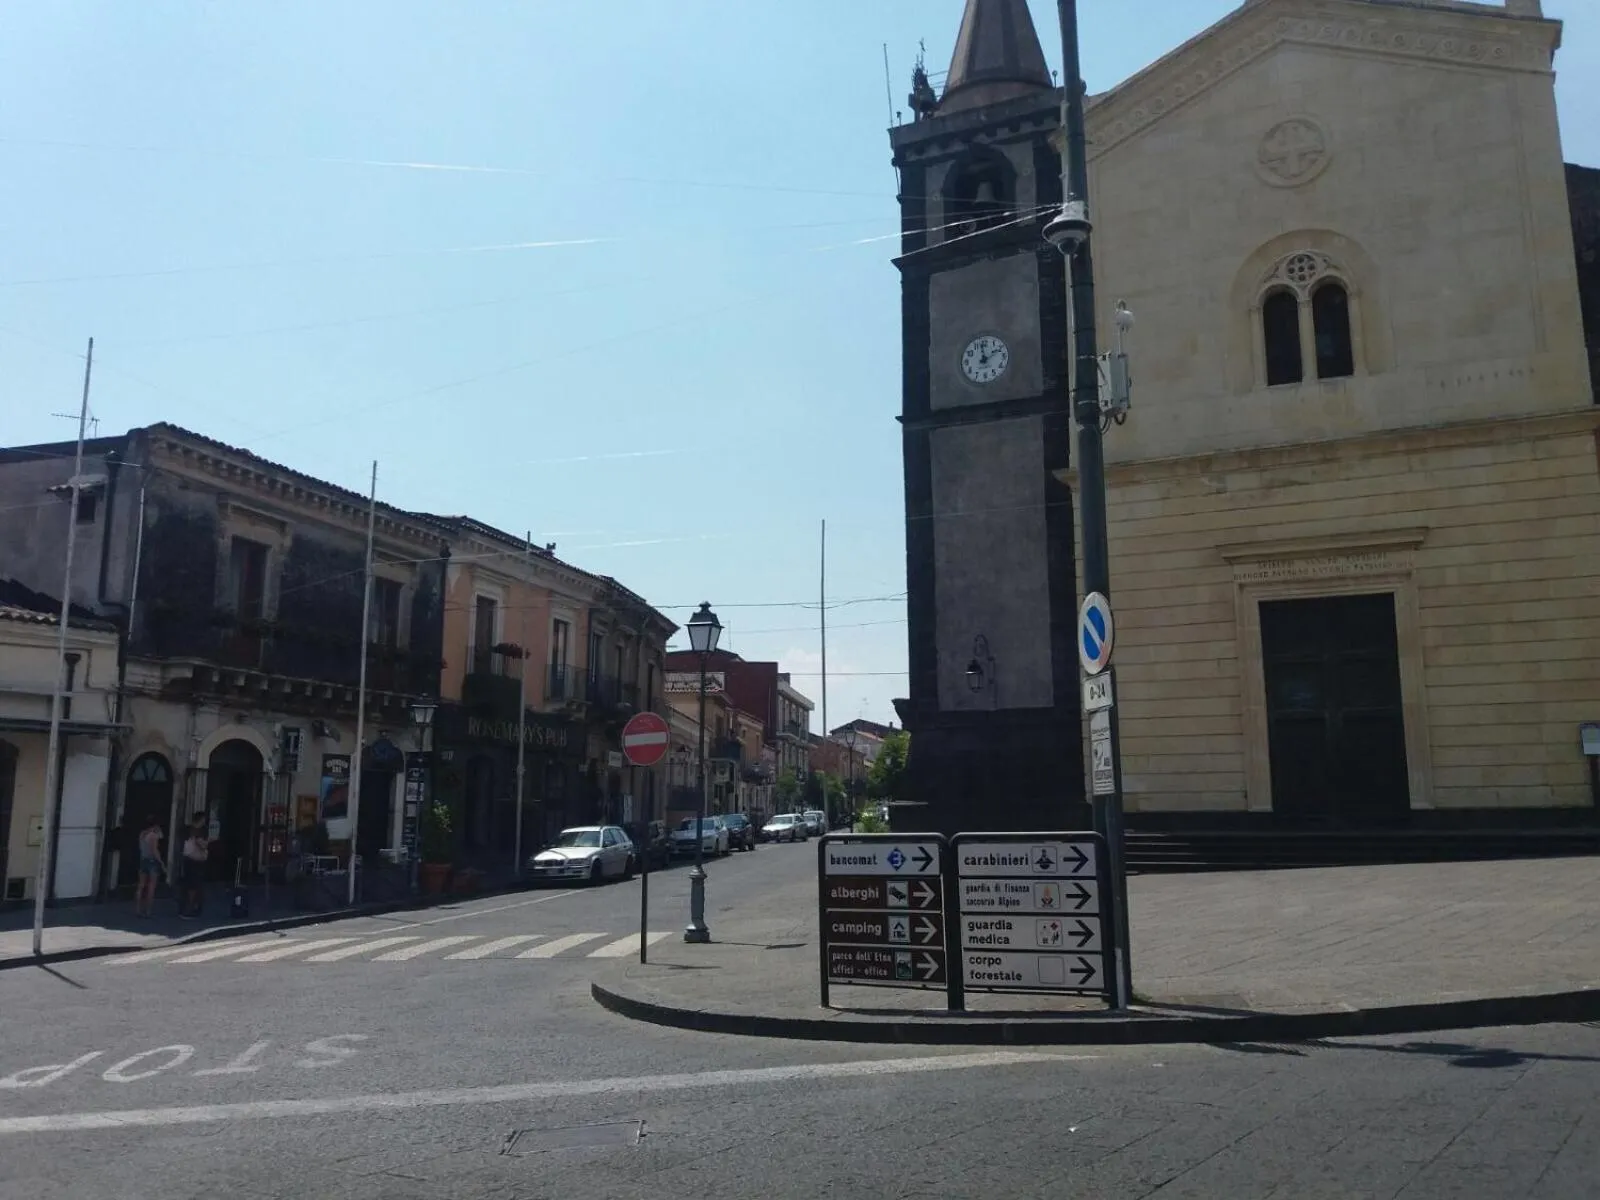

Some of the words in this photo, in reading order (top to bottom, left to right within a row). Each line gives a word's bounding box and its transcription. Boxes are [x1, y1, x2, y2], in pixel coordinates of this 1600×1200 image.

[830, 853, 878, 865] bancomat
[964, 853, 1029, 866] carabinieri
[831, 886, 879, 900] alberghi
[965, 883, 991, 894] guardia
[994, 883, 1001, 893] di
[1004, 883, 1030, 893] finanza
[966, 897, 995, 906] soccorso
[998, 896, 1021, 908] Alpino
[832, 922, 882, 936] camping
[968, 919, 1013, 932] guardia
[968, 934, 1010, 945] medica
[832, 952, 853, 961] parco
[968, 956, 1002, 968] corpo
[969, 970, 1023, 981] forestale
